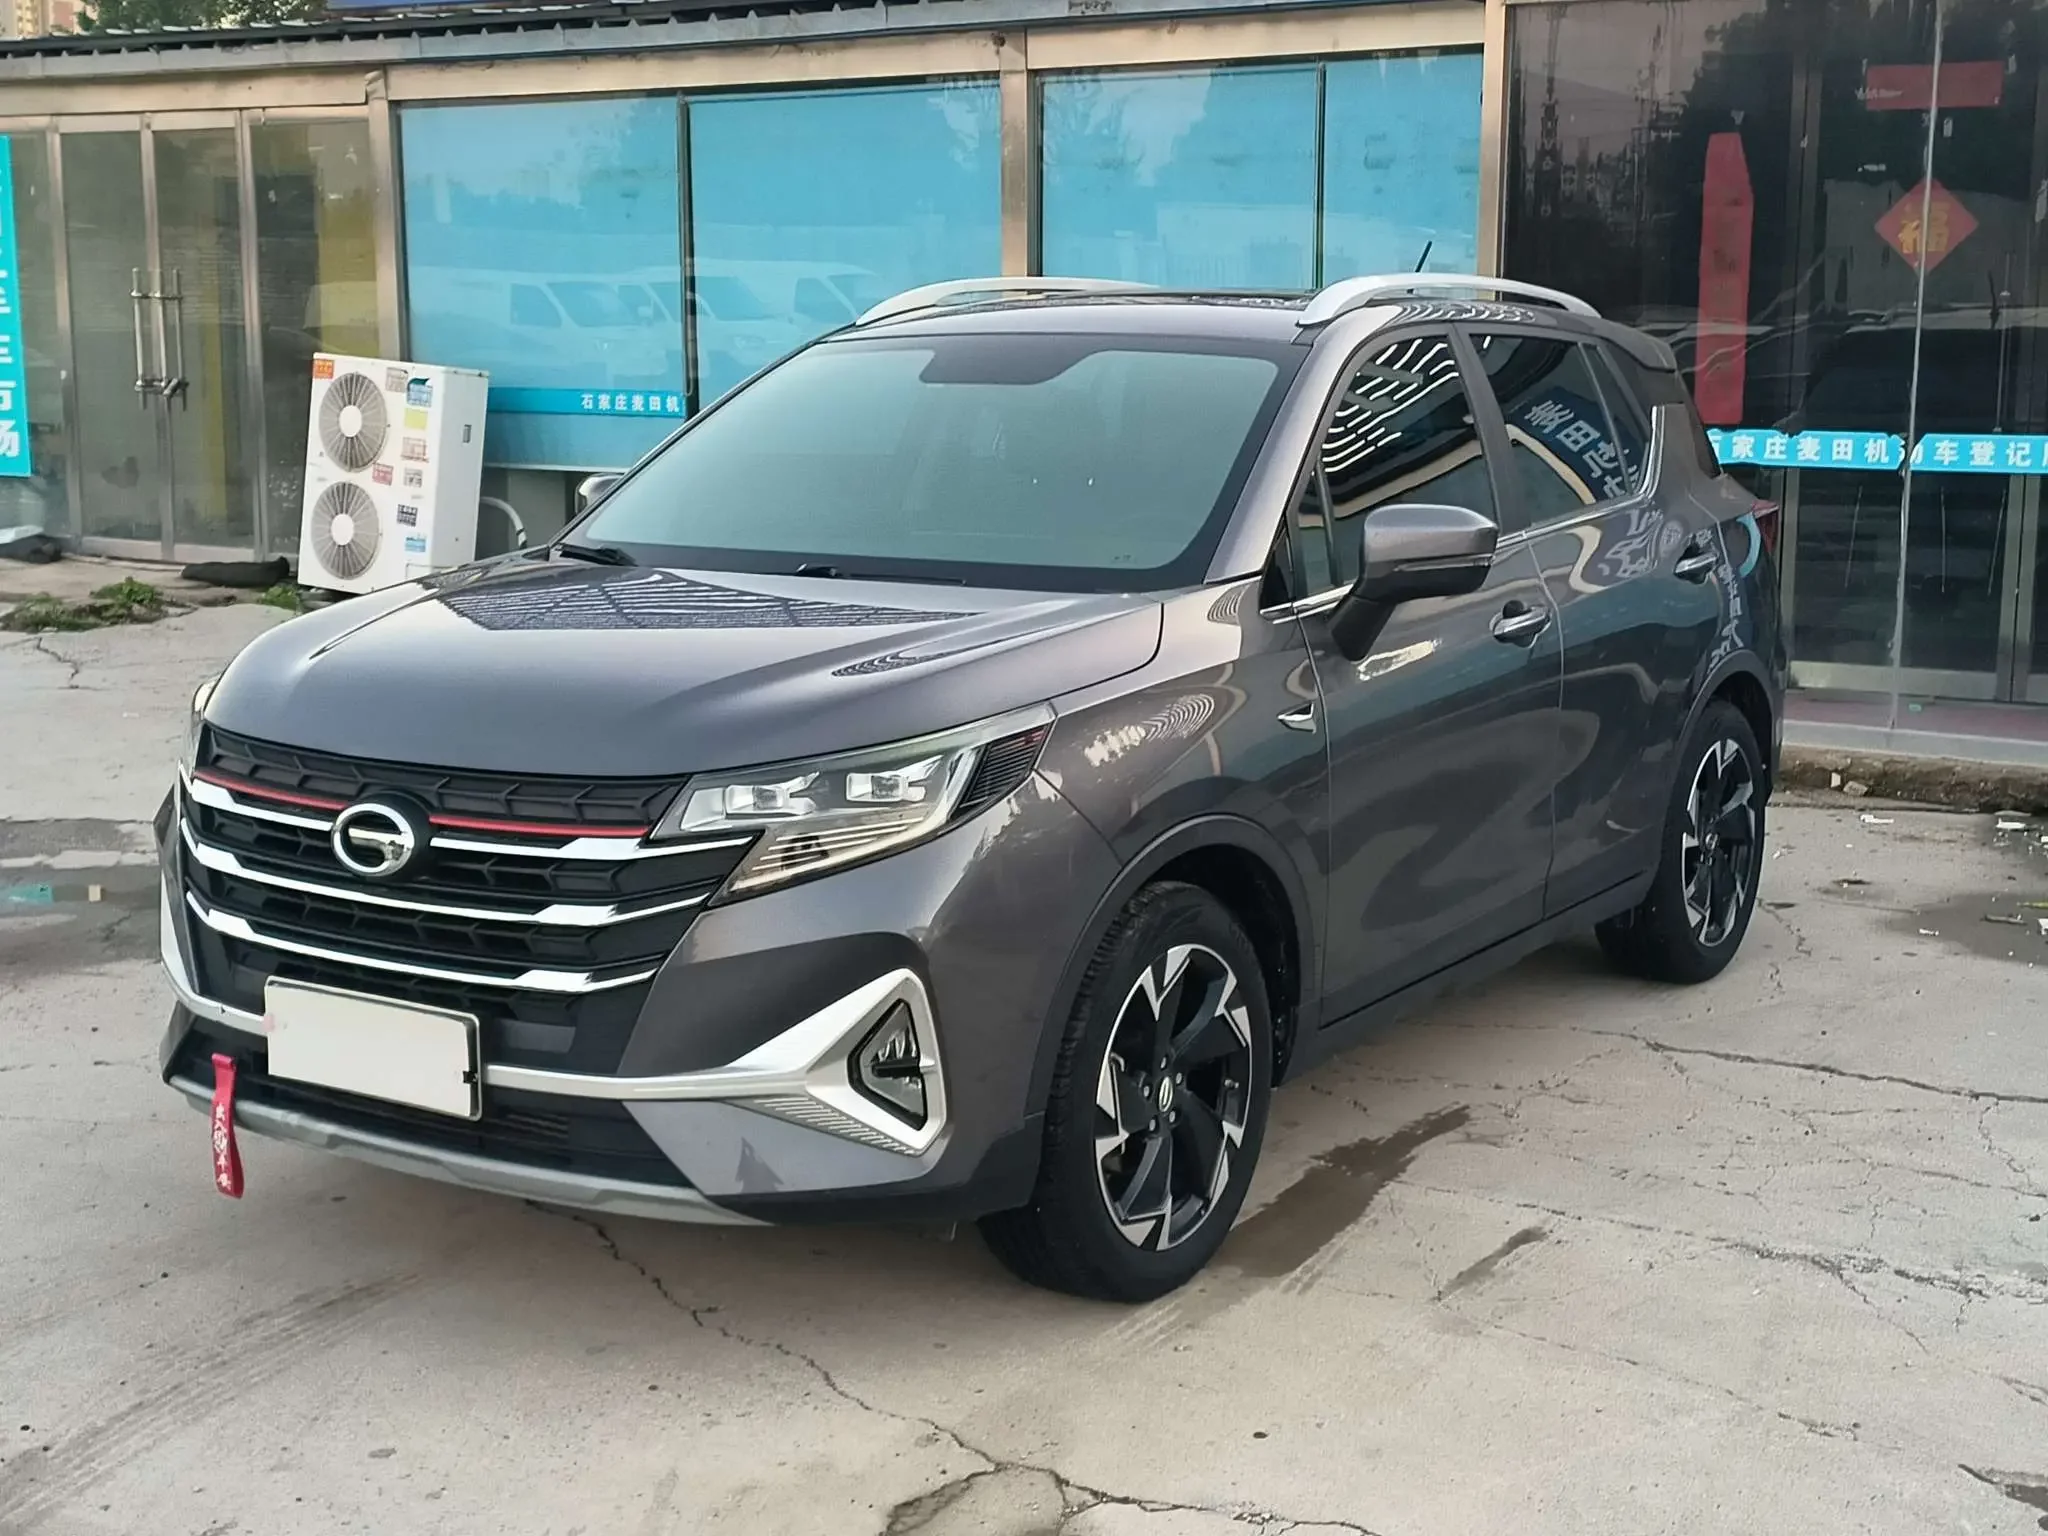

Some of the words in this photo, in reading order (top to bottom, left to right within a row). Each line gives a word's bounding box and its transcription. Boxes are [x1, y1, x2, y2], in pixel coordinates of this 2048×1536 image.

[1897, 200, 1950, 254] 福
[581, 392, 680, 413] 石家庄麦田机
[1708, 434, 2048, 468] 家庄麦田机车登记
